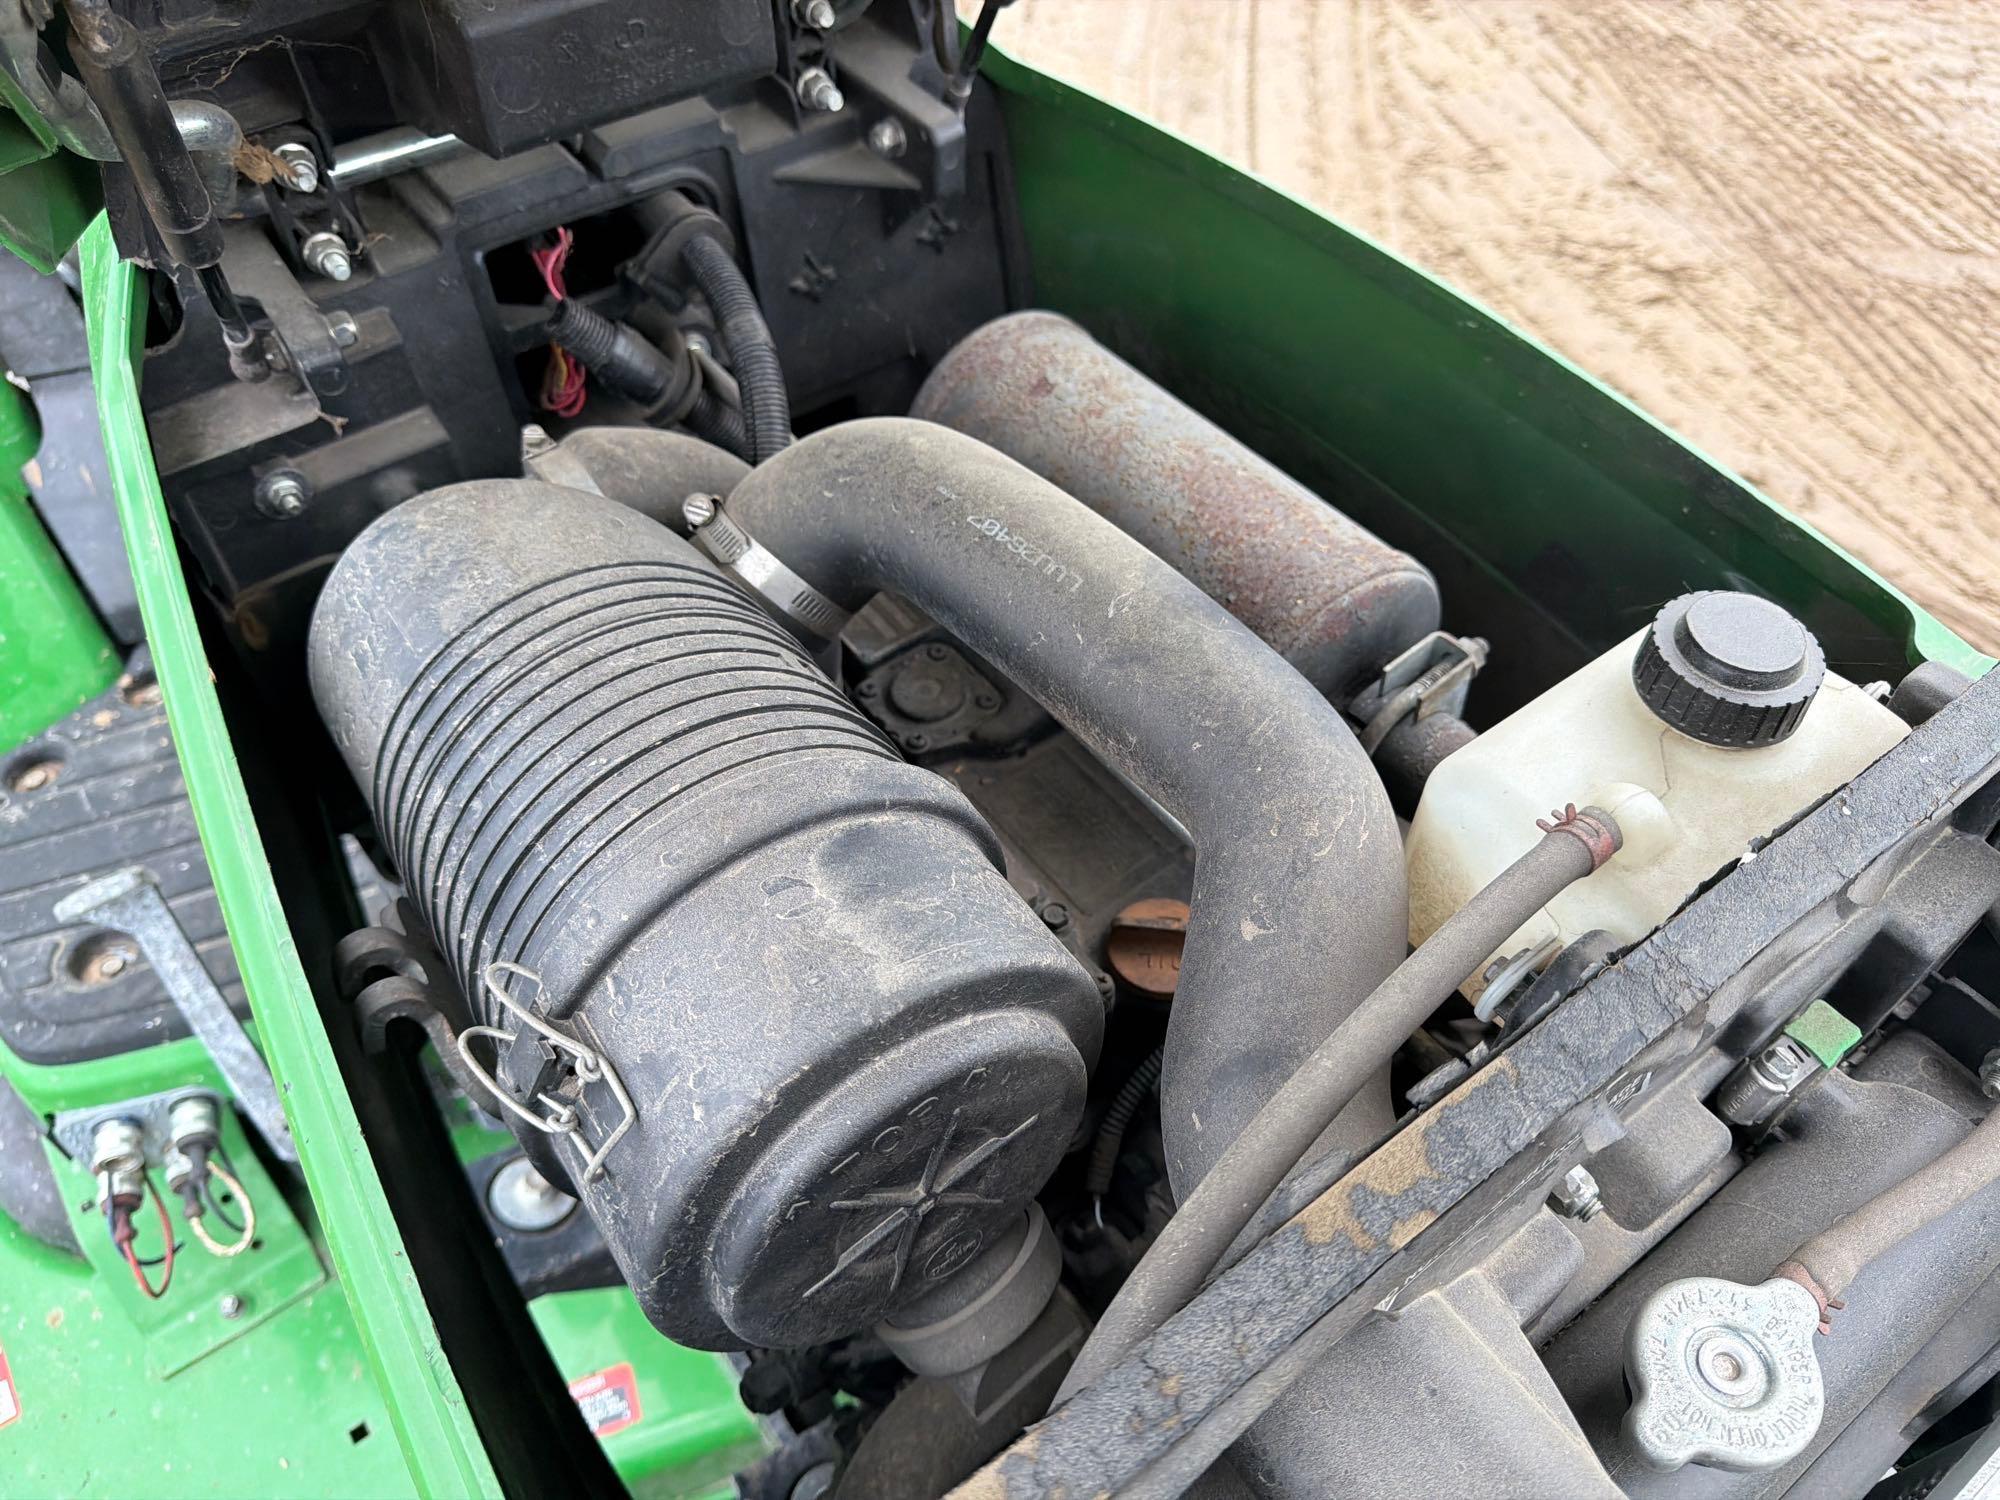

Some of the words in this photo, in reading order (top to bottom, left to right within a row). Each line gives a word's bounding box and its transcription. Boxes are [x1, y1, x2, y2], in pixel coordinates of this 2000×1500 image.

[1765, 1315, 1813, 1386] DANGER
[1680, 1401, 1713, 1432] HOT
[1720, 1423, 1768, 1447] OPEN
[1767, 1395, 1812, 1441] NEVER
